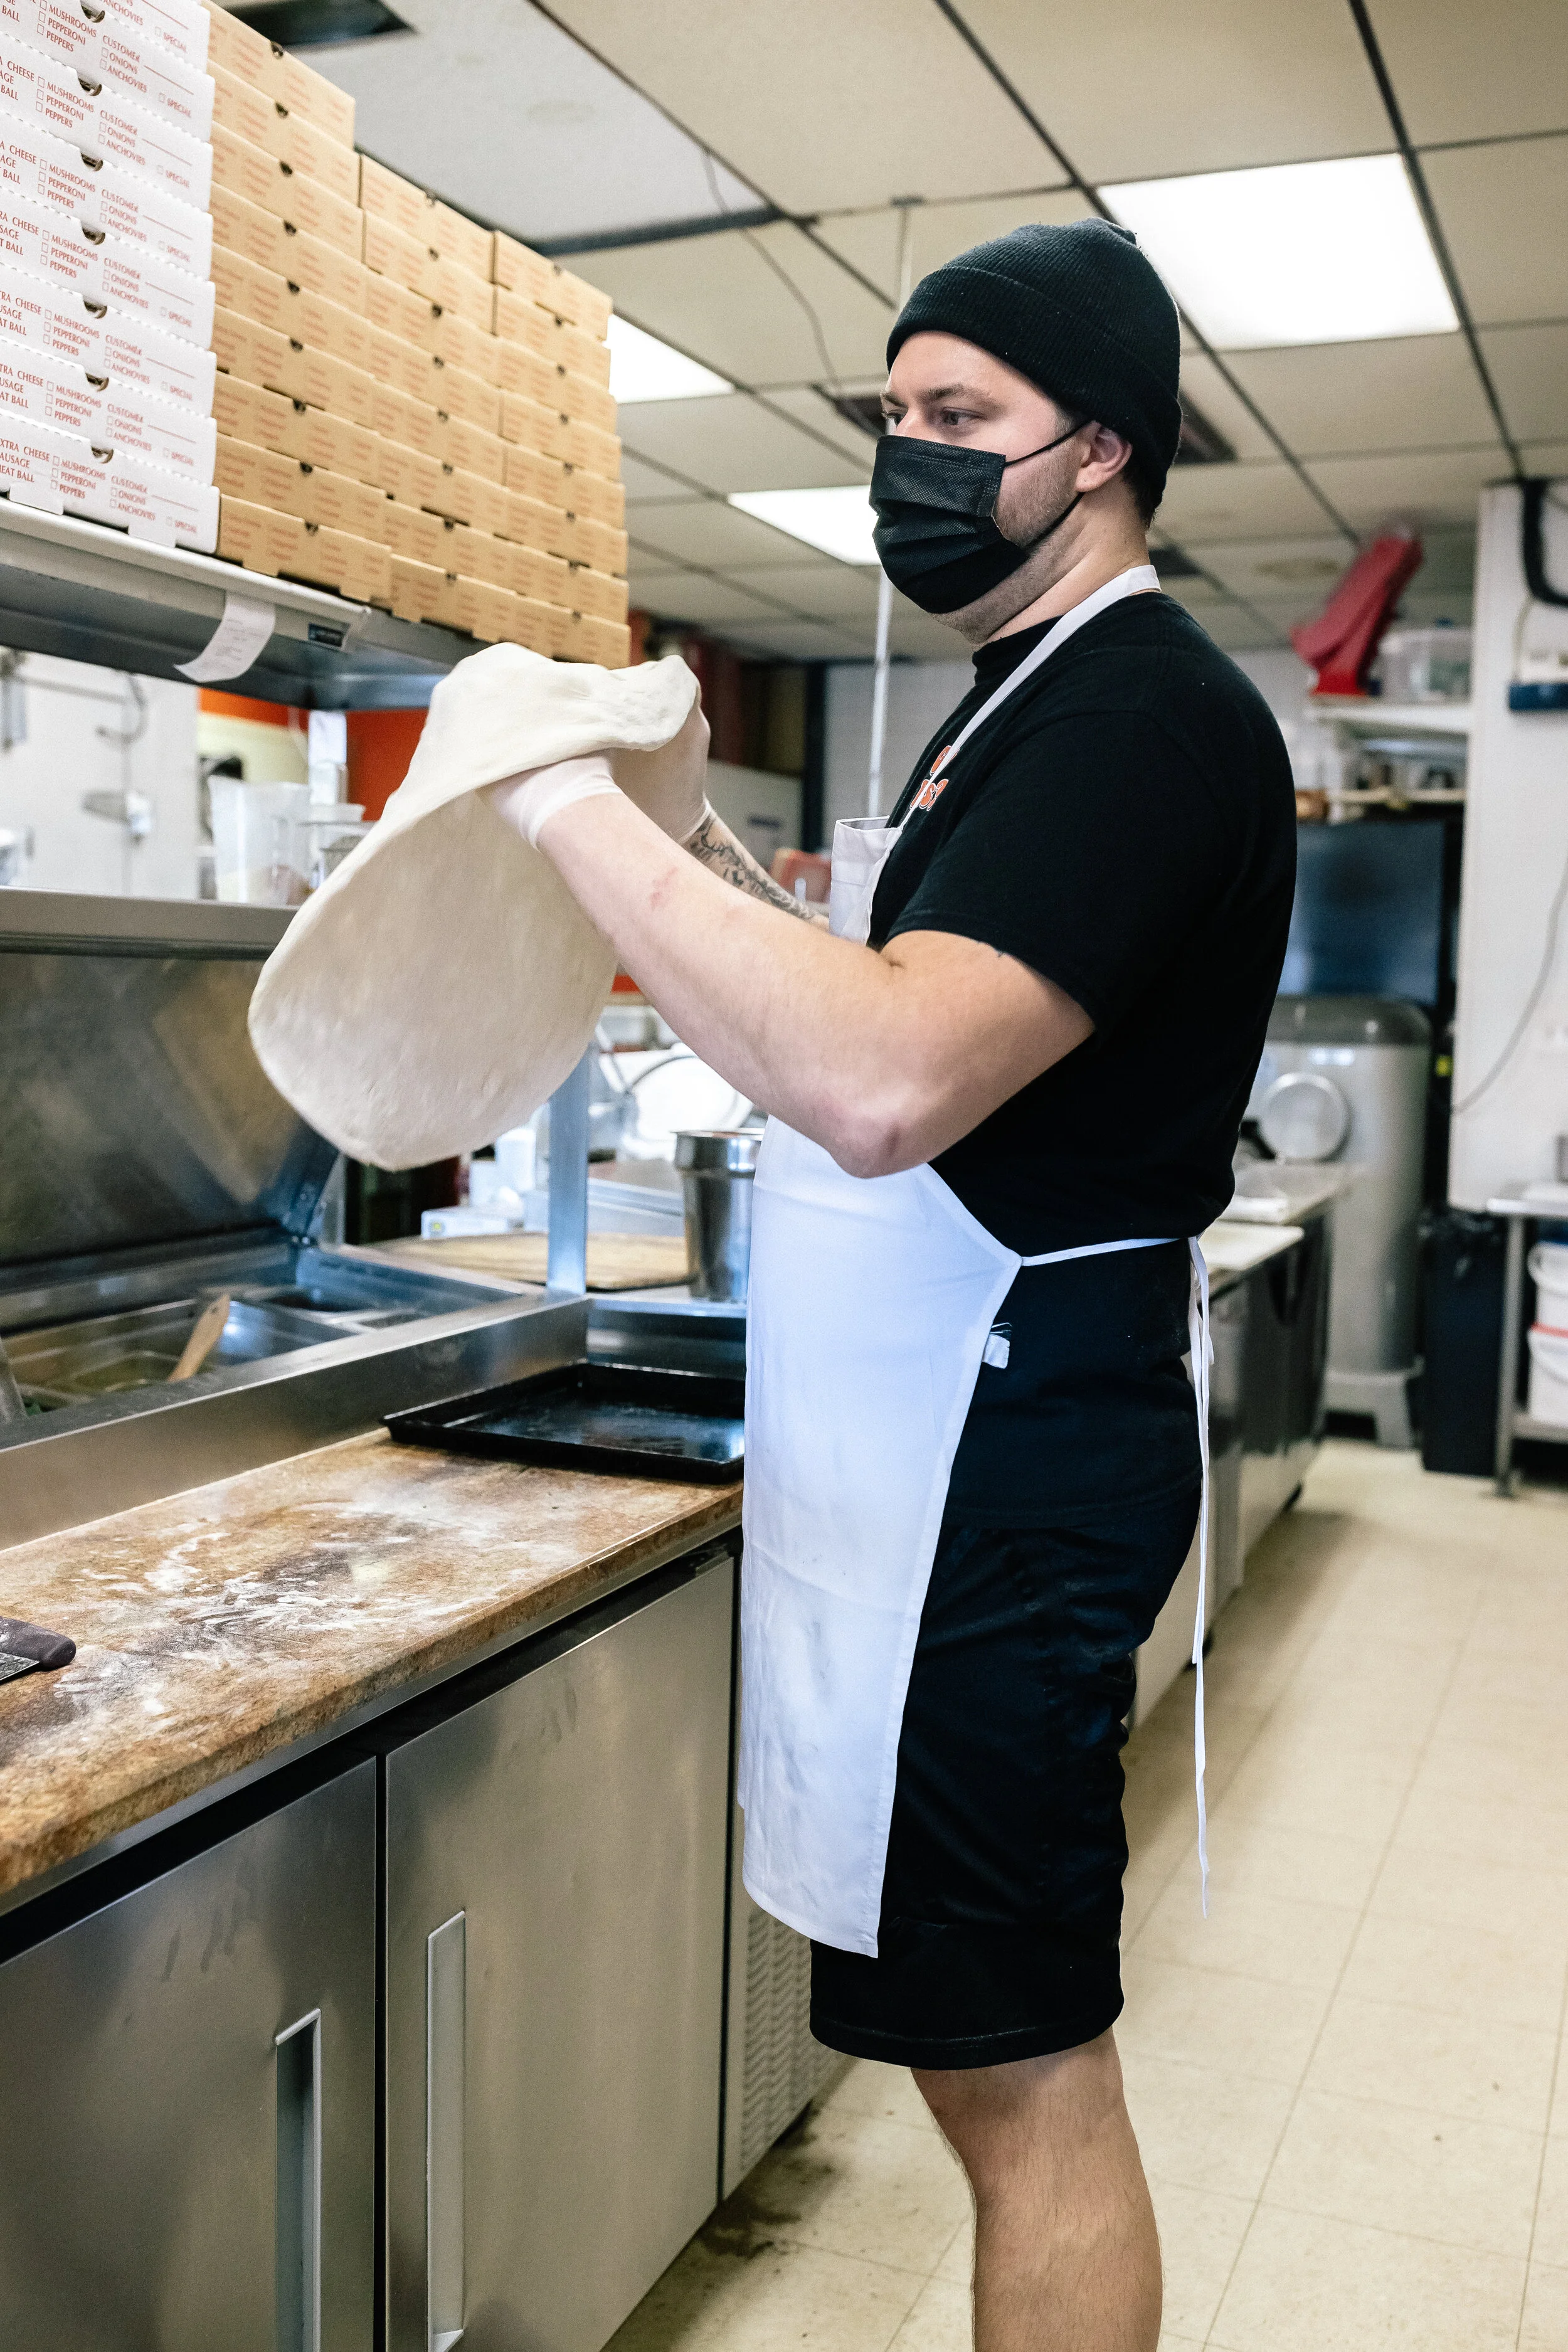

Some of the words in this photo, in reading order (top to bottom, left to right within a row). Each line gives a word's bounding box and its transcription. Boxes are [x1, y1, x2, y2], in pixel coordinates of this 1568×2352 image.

[2, 6, 19, 21] BALL
[49, 5, 97, 37] MUSHROOMS
[46, 31, 74, 51] PEPPERS
[48, 18, 86, 45] PEPPERONI
[103, 35, 140, 62] CUSTOMER
[8, 61, 34, 82] CHEESE
[109, 53, 138, 74] ONIONS
[107, 65, 147, 93] ANCHOVIES
[1, 84, 18, 100] BALL
[47, 82, 94, 113] MUSHROOMS
[46, 95, 84, 120] PEPPERONI
[45, 108, 73, 128] PEPPERS
[100, 110, 137, 135] CUSTOMER
[107, 127, 135, 147] ONIONS
[9, 145, 37, 165] CHEESE
[106, 140, 146, 166] ANCHOVIES
[3, 168, 21, 184] BALL
[49, 165, 95, 192] MUSHROOMS
[48, 177, 86, 200] PEPPERONI
[47, 190, 75, 209] PEPPERS
[13, 216, 39, 235] CHEESE
[6, 240, 24, 256] BALL
[51, 235, 98, 262] MUSHROOMS
[51, 247, 88, 270] PEPPERONI
[50, 261, 77, 278] PEPPERS
[15, 297, 41, 315] CHEESE
[9, 321, 26, 336] BALL
[53, 314, 100, 339] MUSHROOMS
[53, 326, 90, 347] PEPPERONI
[52, 338, 79, 356] PEPPERS
[0, 363, 13, 376] TRA
[17, 370, 43, 387] CHEESE
[0, 378, 24, 393] USAGE
[11, 395, 29, 409] BALL
[56, 385, 102, 408] MUSHROOMS
[55, 397, 92, 418] PEPPERONI
[54, 410, 81, 427] PEPPERS
[0, 438, 19, 452] XTRA
[24, 446, 50, 462] CHEESE
[0, 452, 30, 469] AUSAGE
[61, 459, 106, 480] MUSHROOMS
[0, 465, 14, 477] EAT
[18, 470, 34, 482] BALL
[61, 470, 96, 490] PEPPERONI
[59, 484, 85, 499] PEPPERS
